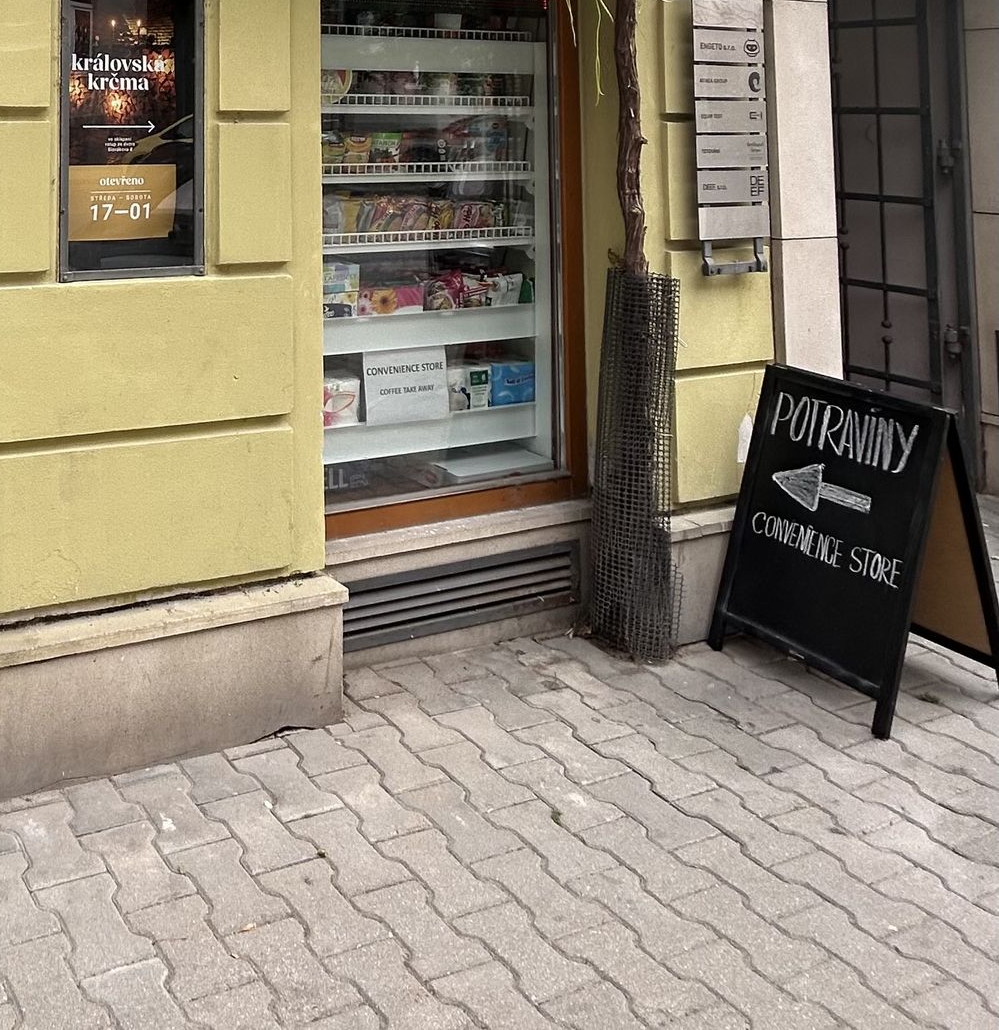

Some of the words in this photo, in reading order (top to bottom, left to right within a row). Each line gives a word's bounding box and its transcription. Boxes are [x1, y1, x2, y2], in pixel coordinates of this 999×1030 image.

[88, 72, 149, 91] krčma
[100, 176, 144, 186] otevřeno
[366, 364, 420, 376] CONVENIENCE
[421, 362, 444, 372] STORE
[380, 387, 402, 396] COFFEE
[403, 386, 417, 394] TAKE
[418, 384, 434, 393] AWAY
[771, 392, 919, 473] POTRAVINY
[752, 511, 843, 568] CONVENIENCE
[849, 546, 903, 589] STORE
